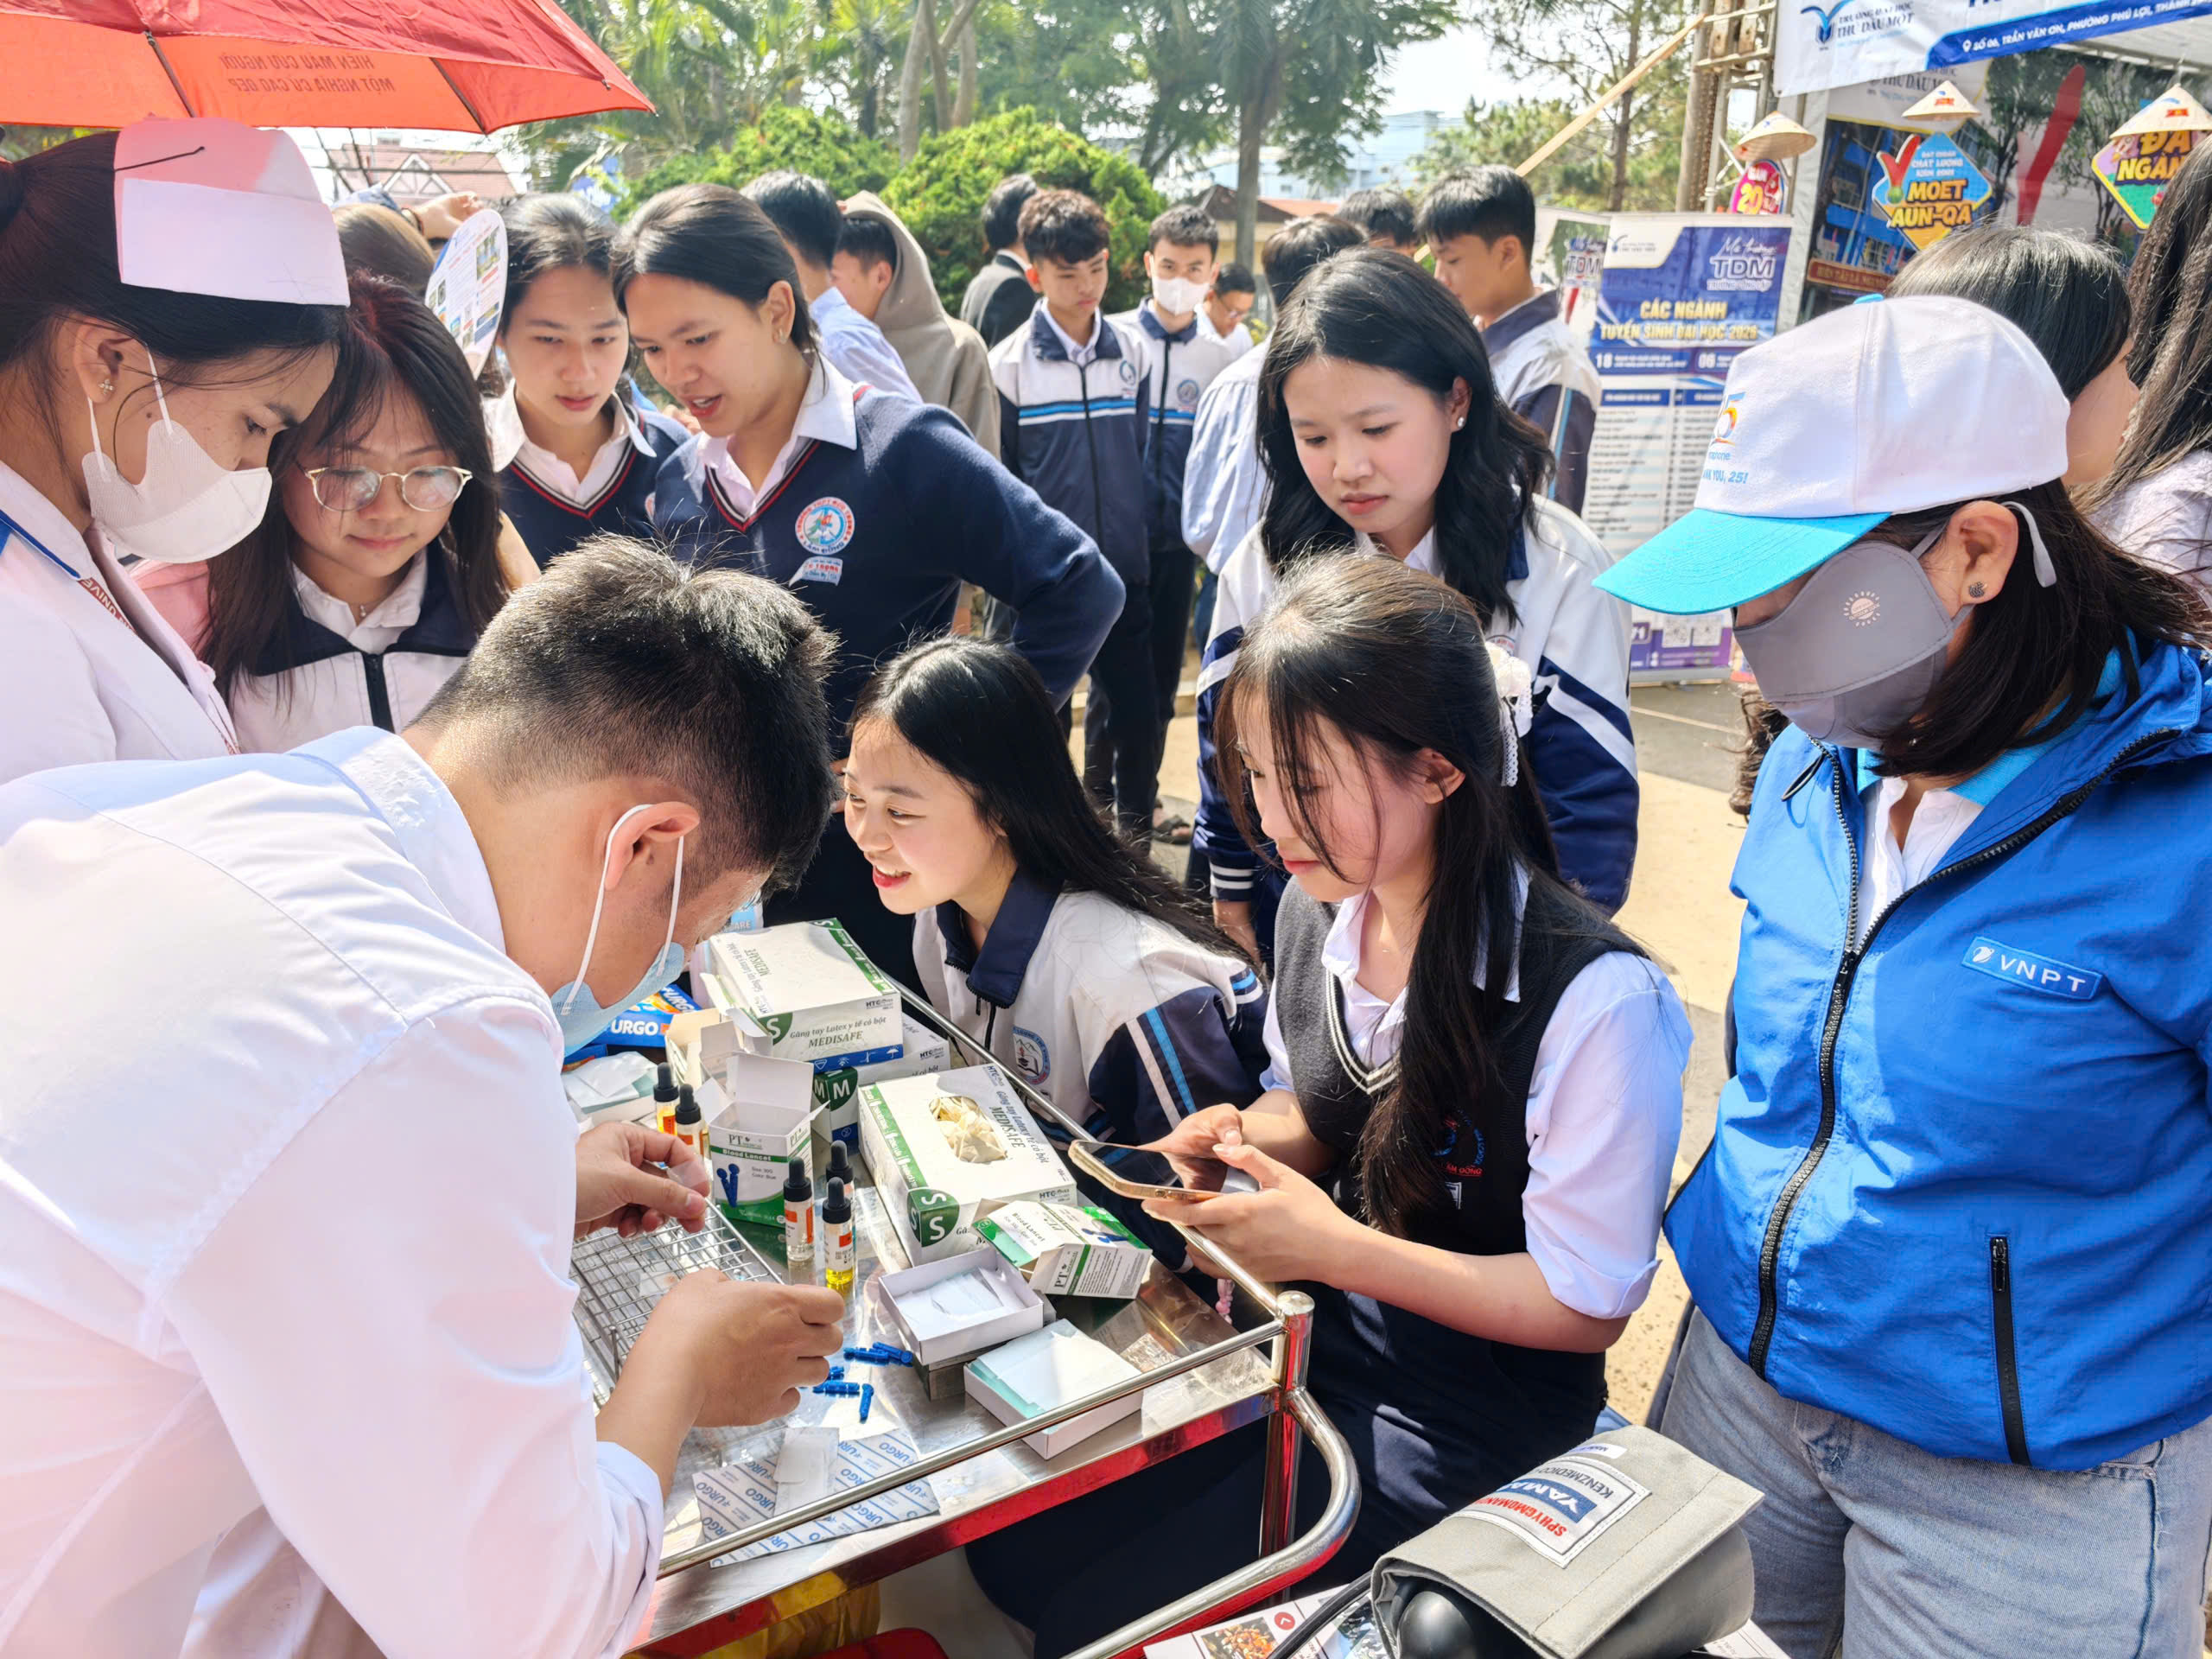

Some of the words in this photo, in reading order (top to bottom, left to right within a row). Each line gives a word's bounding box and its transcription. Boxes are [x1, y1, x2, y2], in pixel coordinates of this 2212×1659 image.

[2117, 154, 2184, 181] NGÀN
[1907, 179, 1967, 201] MOET
[1891, 205, 1972, 227] AUN-QA
[1710, 257, 1775, 278] TDM
[1640, 297, 1670, 320] CÁC
[1674, 297, 1727, 320] NGÀNH
[1643, 324, 1675, 340] SINH
[1728, 470, 1749, 484] 25!
[1999, 954, 2087, 992] VNPT
[610, 1020, 658, 1036] URGO
[766, 1017, 781, 1040] S
[790, 1027, 810, 1039] Găng
[812, 1027, 824, 1037] tay
[808, 1030, 864, 1049] MEDISAFE
[833, 1078, 851, 1100] M
[989, 1106, 1027, 1149] MEDISAFE
[728, 1134, 743, 1146] PT
[722, 1148, 743, 1159] Blood
[745, 1151, 772, 1161] Lancet
[1039, 1190, 1057, 1199] HTC
[929, 1216, 946, 1241] S
[1053, 1271, 1068, 1287] PT
[879, 1442, 910, 1465] URGO
[696, 1482, 727, 1503] URGO
[1475, 1496, 1567, 1537] SPHYGMOMAN
